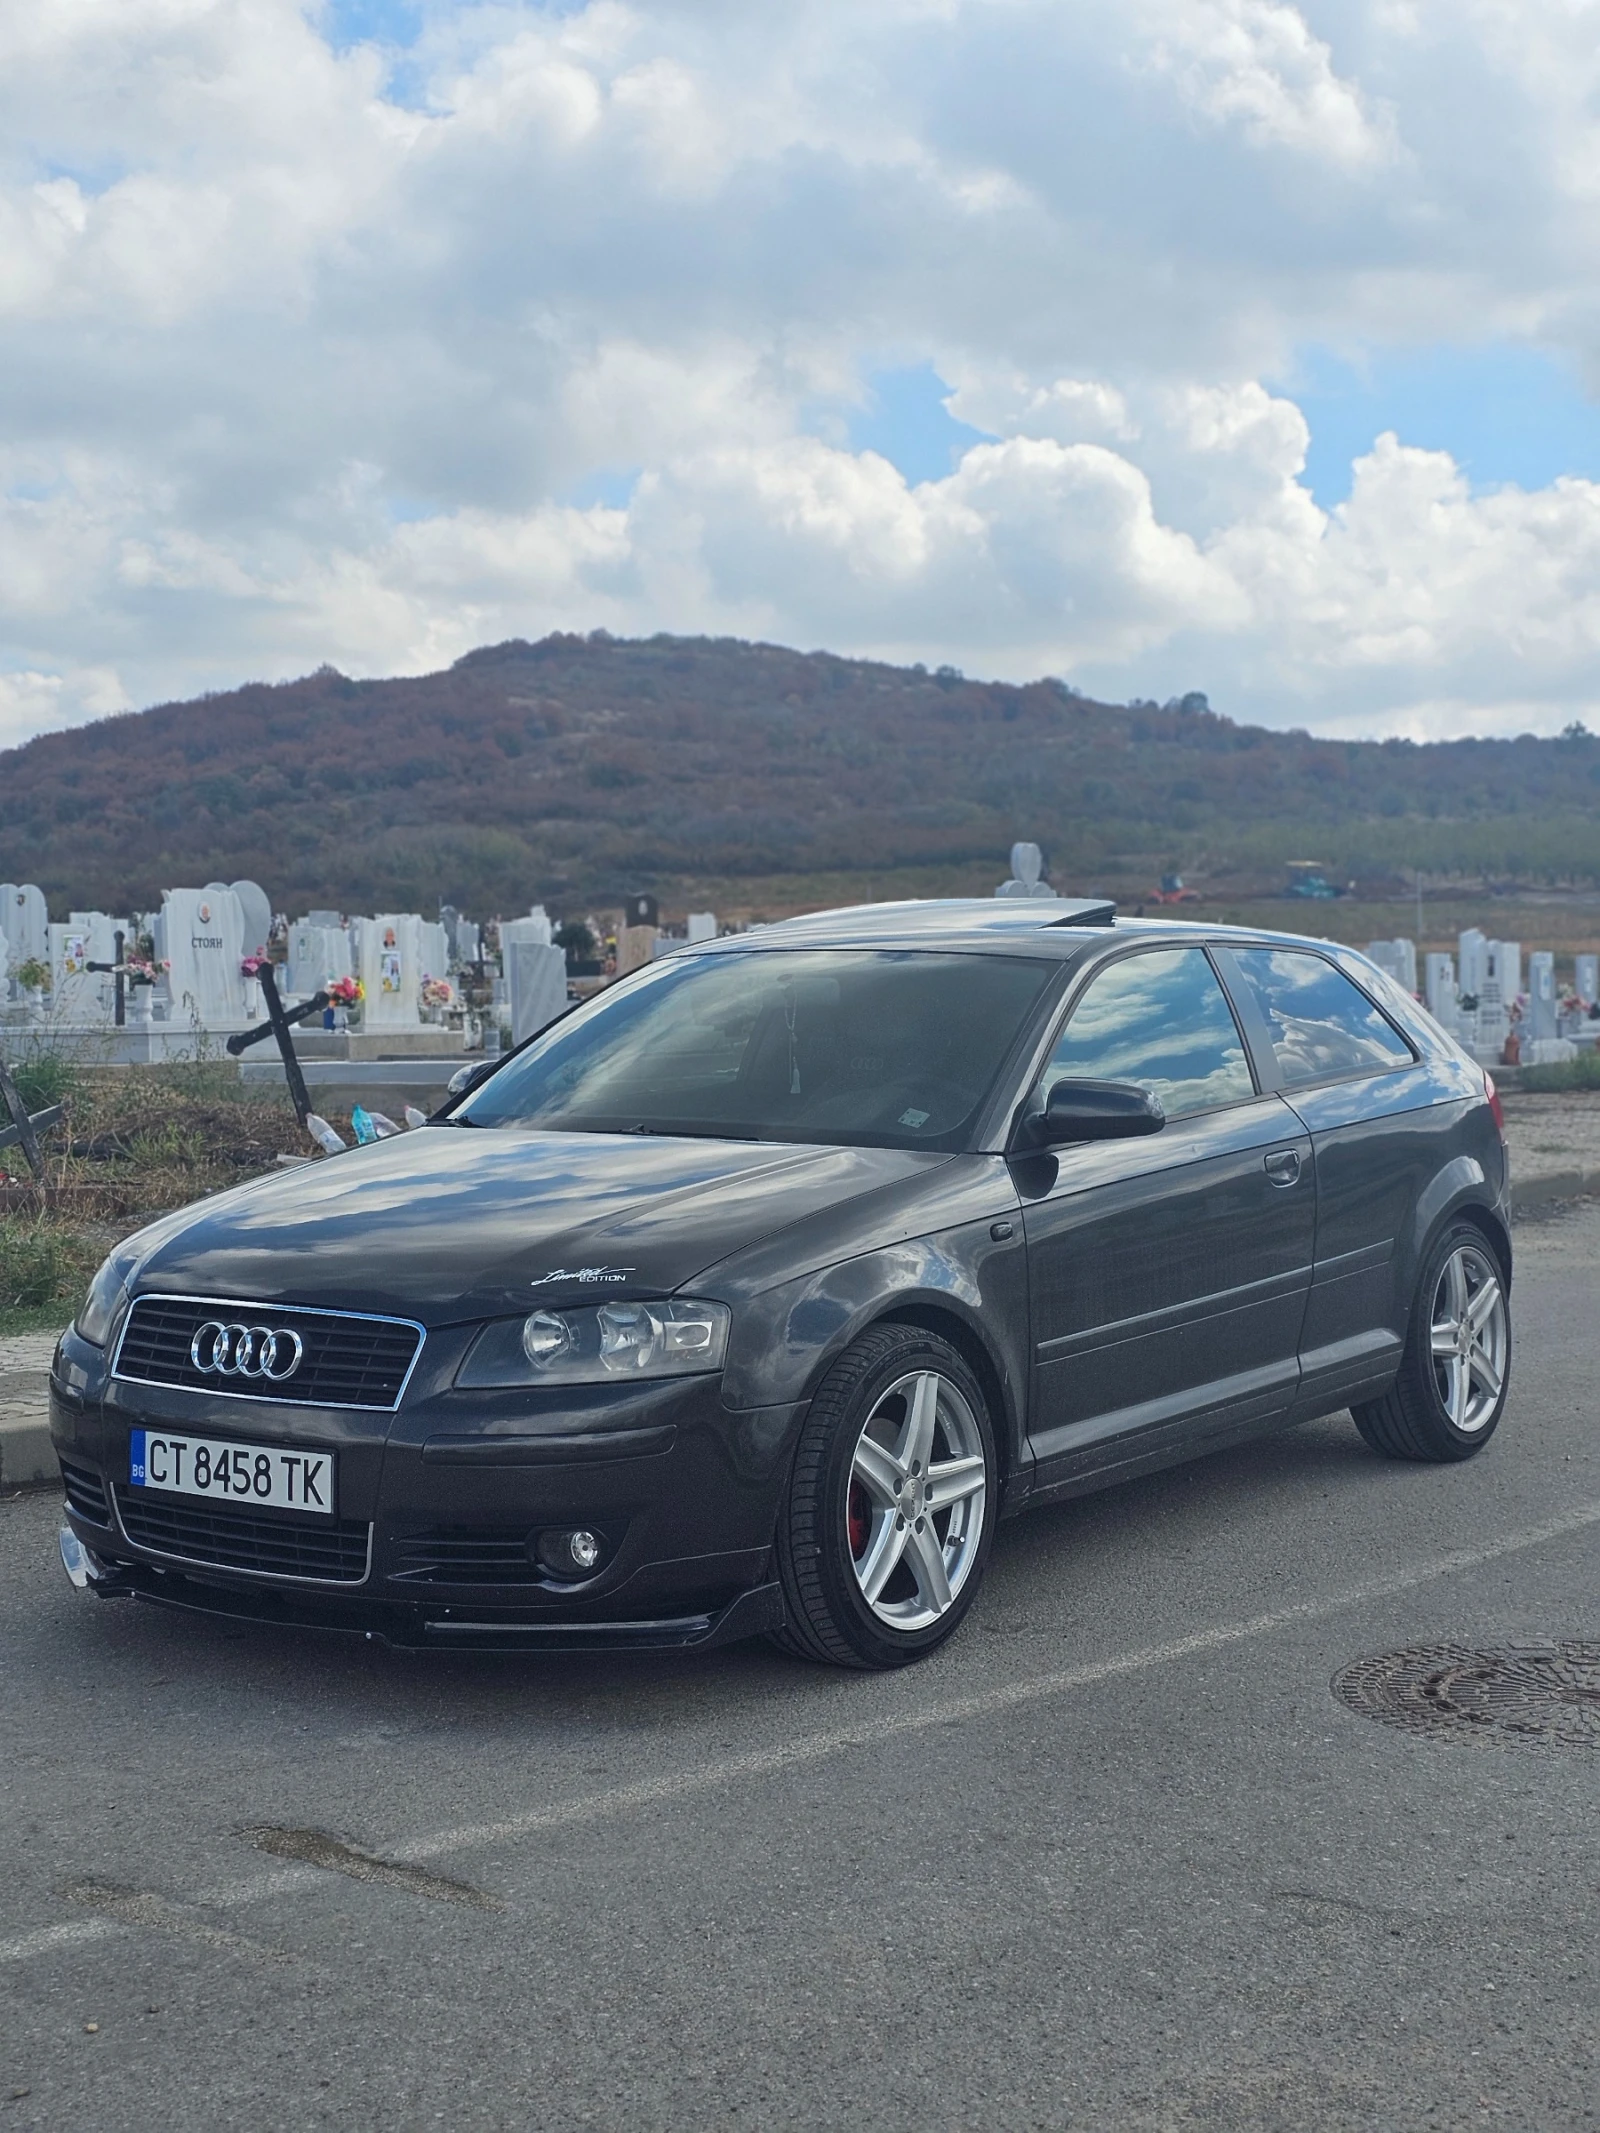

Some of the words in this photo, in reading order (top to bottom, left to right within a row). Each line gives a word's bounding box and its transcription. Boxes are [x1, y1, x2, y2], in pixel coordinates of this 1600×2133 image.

[191, 937, 223, 949] СТОЯН
[132, 1464, 145, 1477] BG
[194, 1446, 272, 1497] 8458
[281, 1456, 325, 1506] TK
